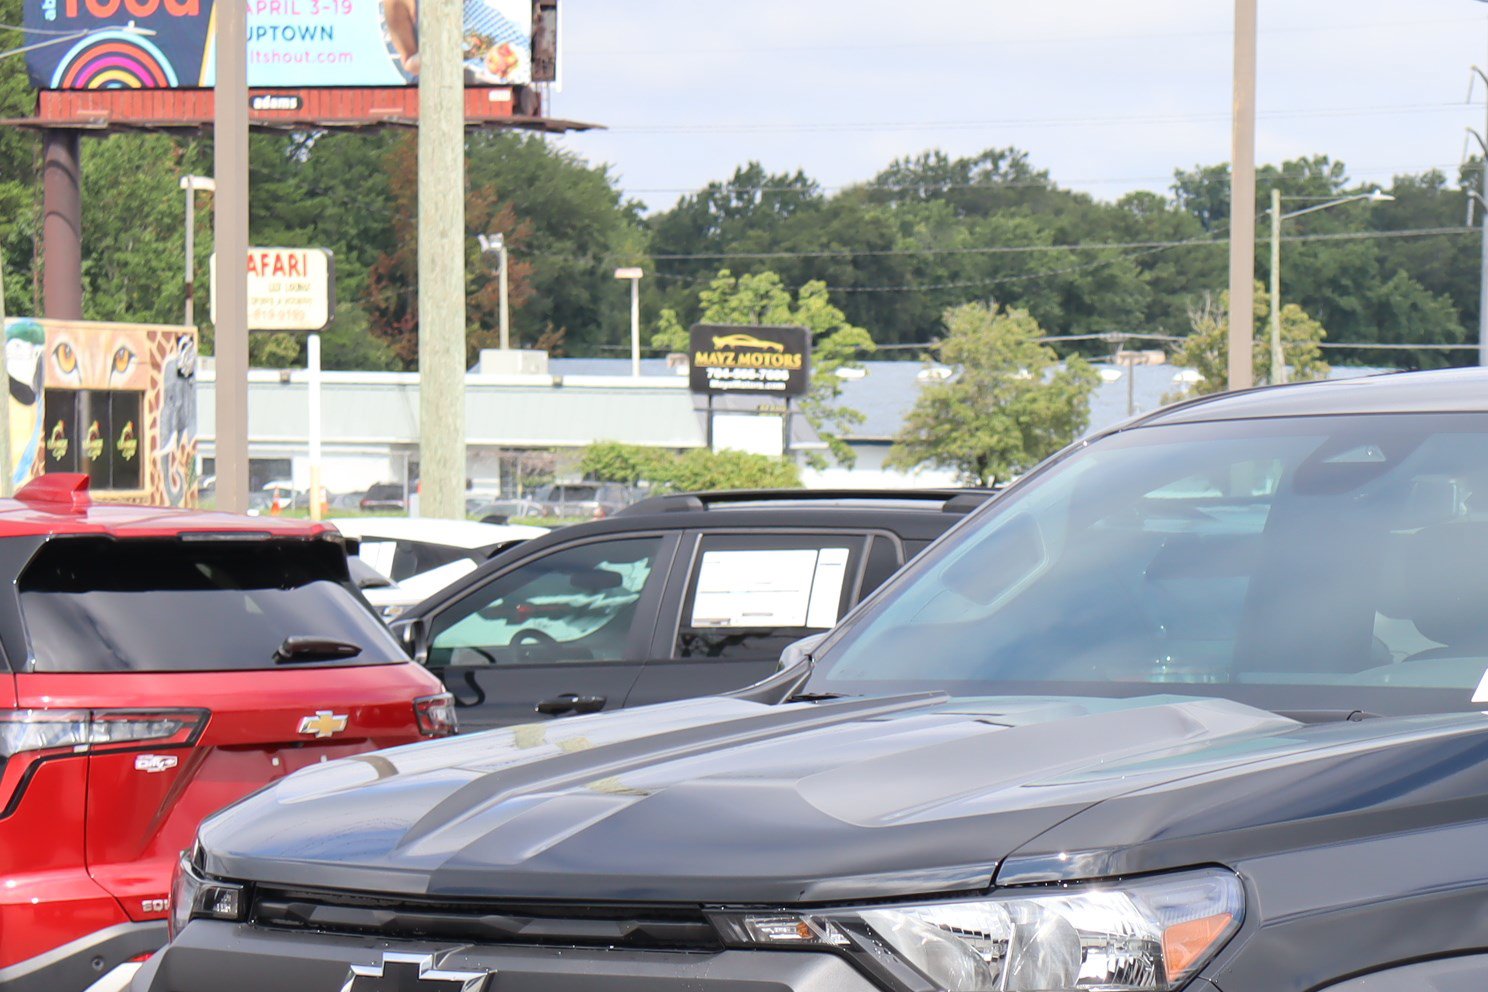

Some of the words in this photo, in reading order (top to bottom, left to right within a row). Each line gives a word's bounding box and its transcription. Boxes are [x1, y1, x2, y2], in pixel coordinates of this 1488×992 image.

[310, 0, 353, 15] 3-19
[250, 49, 353, 63] ltshout.com
[252, 95, 299, 110] adams
[247, 253, 308, 277] AFARI
[694, 351, 736, 368] MAYZ
[737, 352, 802, 370] MOTORS
